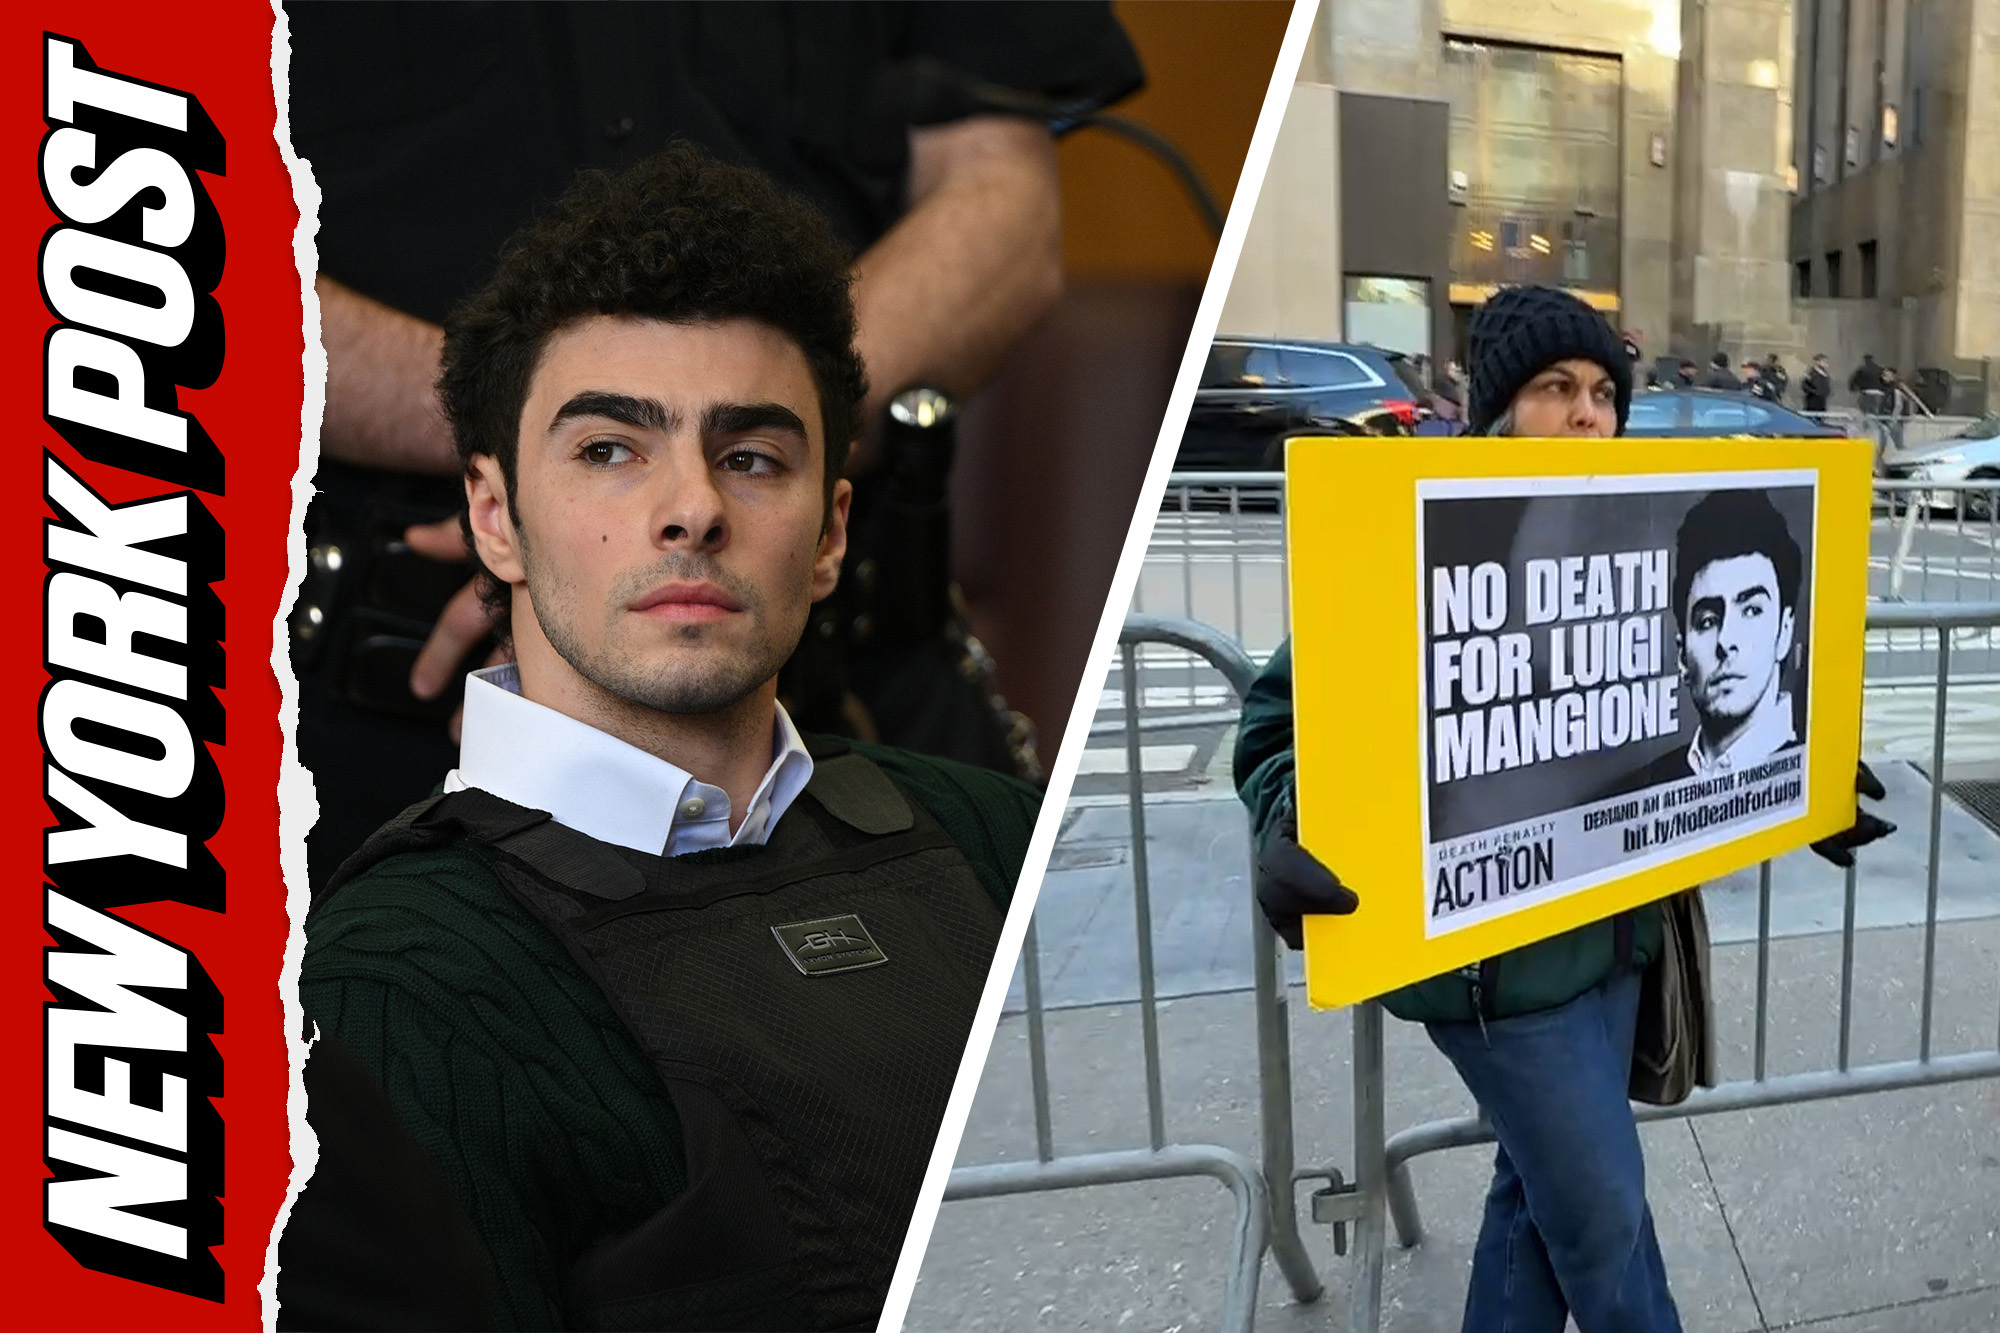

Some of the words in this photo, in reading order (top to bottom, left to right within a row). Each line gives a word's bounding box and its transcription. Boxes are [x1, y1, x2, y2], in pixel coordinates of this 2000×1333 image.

[1432, 561, 1508, 636] NO
[1525, 549, 1669, 626] DEATH
[1433, 632, 1533, 710] FOR
[1550, 615, 1662, 692] LUIGI
[1434, 674, 1679, 784] MANGIONE
[1583, 800, 1639, 832] DEMAND
[1642, 794, 1660, 817] AN
[1663, 773, 1736, 808] ALTERNATIVE
[1738, 753, 1802, 789] PUNISHMENT
[1623, 775, 1802, 852] bit.ly/NoDeathForLuigi
[1432, 837, 1553, 918] ACTION
[1438, 840, 1487, 861] DEATH
[1494, 821, 1556, 844] PENALTY
[803, 953, 834, 964] ARMOR
[835, 947, 874, 960] SYSTEMS
